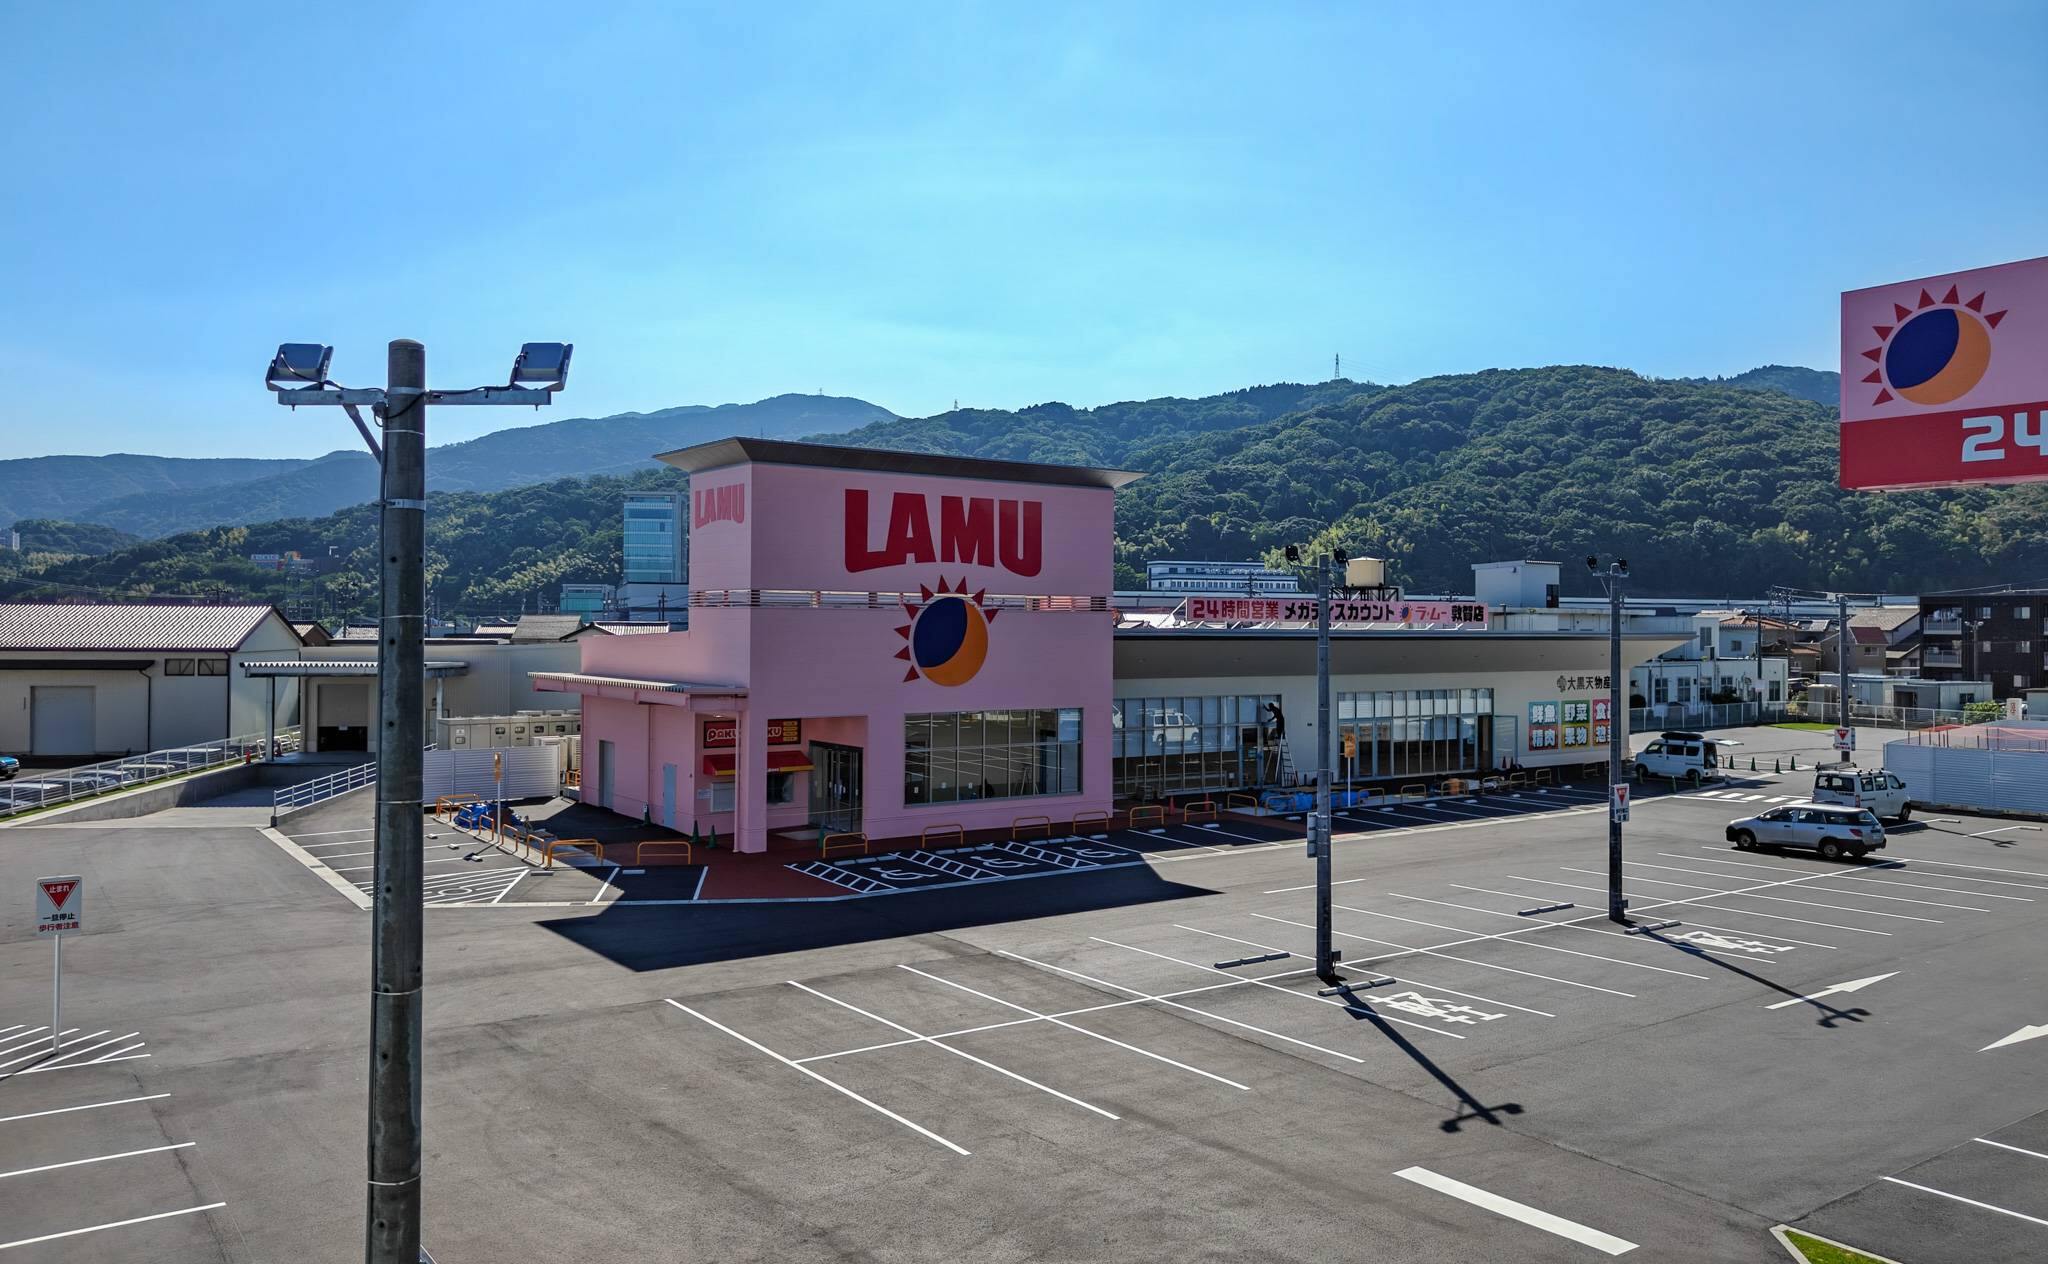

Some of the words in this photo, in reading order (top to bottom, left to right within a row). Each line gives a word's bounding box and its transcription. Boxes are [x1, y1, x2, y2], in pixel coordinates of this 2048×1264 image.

[1961, 409, 2048, 463] 24
[694, 483, 745, 530] LAMU
[845, 489, 1043, 577] LAMU
[1193, 600, 1279, 620] 24時間営業
[1567, 676, 1611, 690] 大黒天物産
[1564, 703, 1588, 721] 野菜
[1595, 702, 1611, 720] 食
[1564, 727, 1587, 745] 果物
